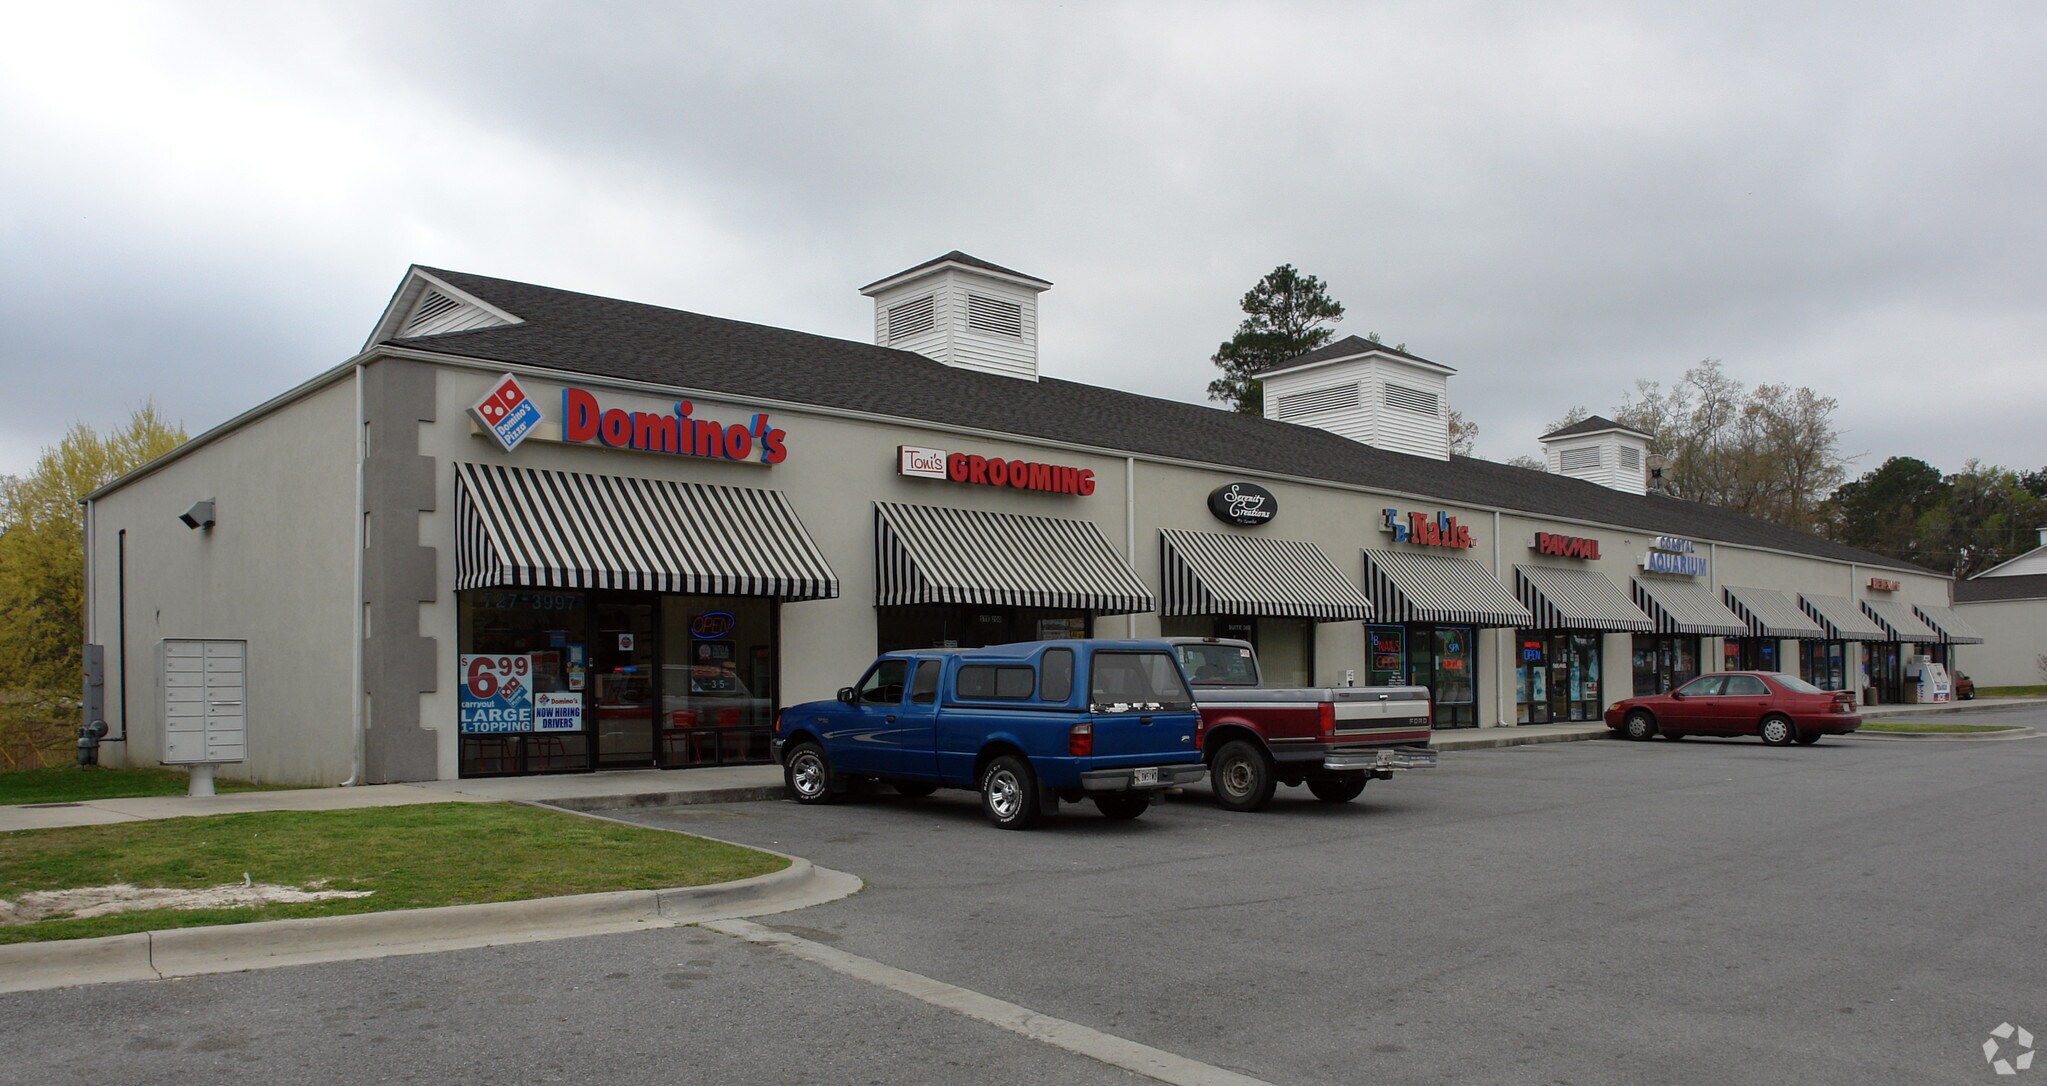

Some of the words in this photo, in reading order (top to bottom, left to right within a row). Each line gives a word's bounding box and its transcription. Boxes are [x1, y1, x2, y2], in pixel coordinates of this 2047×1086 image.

[496, 403, 532, 436] Domino's
[563, 388, 787, 464] Domino's
[504, 423, 527, 444] Pizza
[904, 450, 943, 470] Toni's
[948, 452, 1096, 496] GROOMING
[1224, 485, 1265, 510] Serenity
[1230, 500, 1270, 518] Creations
[1411, 511, 1470, 549] Nails
[1659, 537, 1695, 554] COASTAL
[1648, 552, 1707, 577] AQUARIUM
[483, 592, 577, 611] 727-3997
[692, 615, 732, 634] OPEN
[1377, 640, 1400, 652] NAILS
[1448, 643, 1460, 653] SPA
[1375, 655, 1399, 670] OPEN
[1523, 649, 1540, 661] OPEN
[550, 697, 578, 705] Domino's
[460, 708, 531, 722] LARGE
[536, 707, 553, 718] NOW
[554, 707, 580, 717] HIRING
[1409, 717, 1428, 725] FORD
[461, 722, 531, 733] 1-TOPPING
[542, 718, 574, 729] DRIVERS
